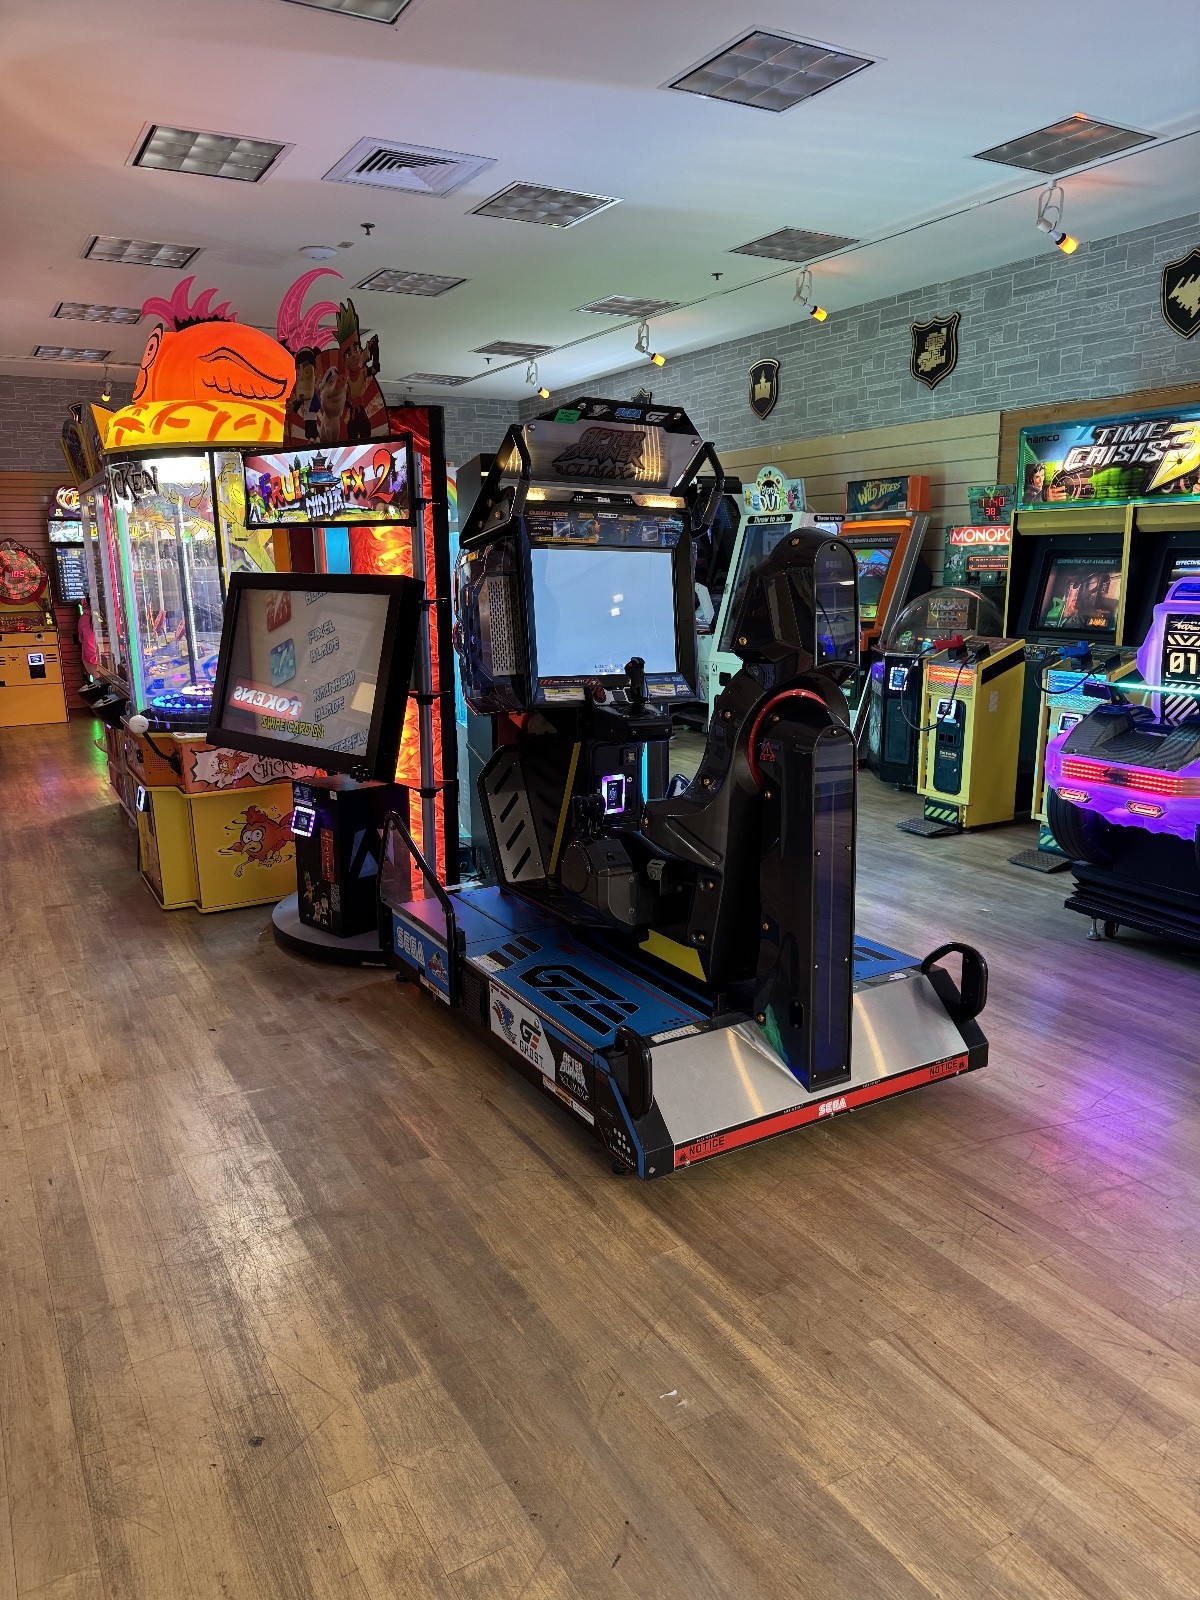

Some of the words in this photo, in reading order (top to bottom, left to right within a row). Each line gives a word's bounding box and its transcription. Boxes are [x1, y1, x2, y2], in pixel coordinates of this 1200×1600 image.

[581, 427, 646, 450] AFTER
[1027, 434, 1059, 444] namco
[1096, 421, 1168, 445] TIME
[562, 442, 645, 470] BURNER
[1063, 440, 1171, 473] CRISIS
[259, 465, 311, 507] FRUIT
[341, 466, 367, 496] FX
[368, 449, 395, 503] 2
[565, 461, 632, 480] CLIMAX
[305, 487, 345, 519] NINJA
[307, 619, 336, 644] PIXEL
[309, 637, 340, 664] BLADE
[1170, 652, 1197, 675] 01
[312, 670, 356, 702] RAINBOW
[314, 696, 345, 722] BLADE
[261, 715, 286, 732] SWIPE
[286, 720, 310, 736] CARD
[311, 722, 325, 740] ON
[397, 926, 425, 966] SEGA
[519, 1040, 543, 1067] GHOST
[562, 1051, 584, 1073] AFTER
[559, 1061, 588, 1092] BURNER
[930, 1059, 957, 1076] NOTICE
[818, 1097, 847, 1116] SEGA
[689, 1136, 725, 1156] NOTICE
